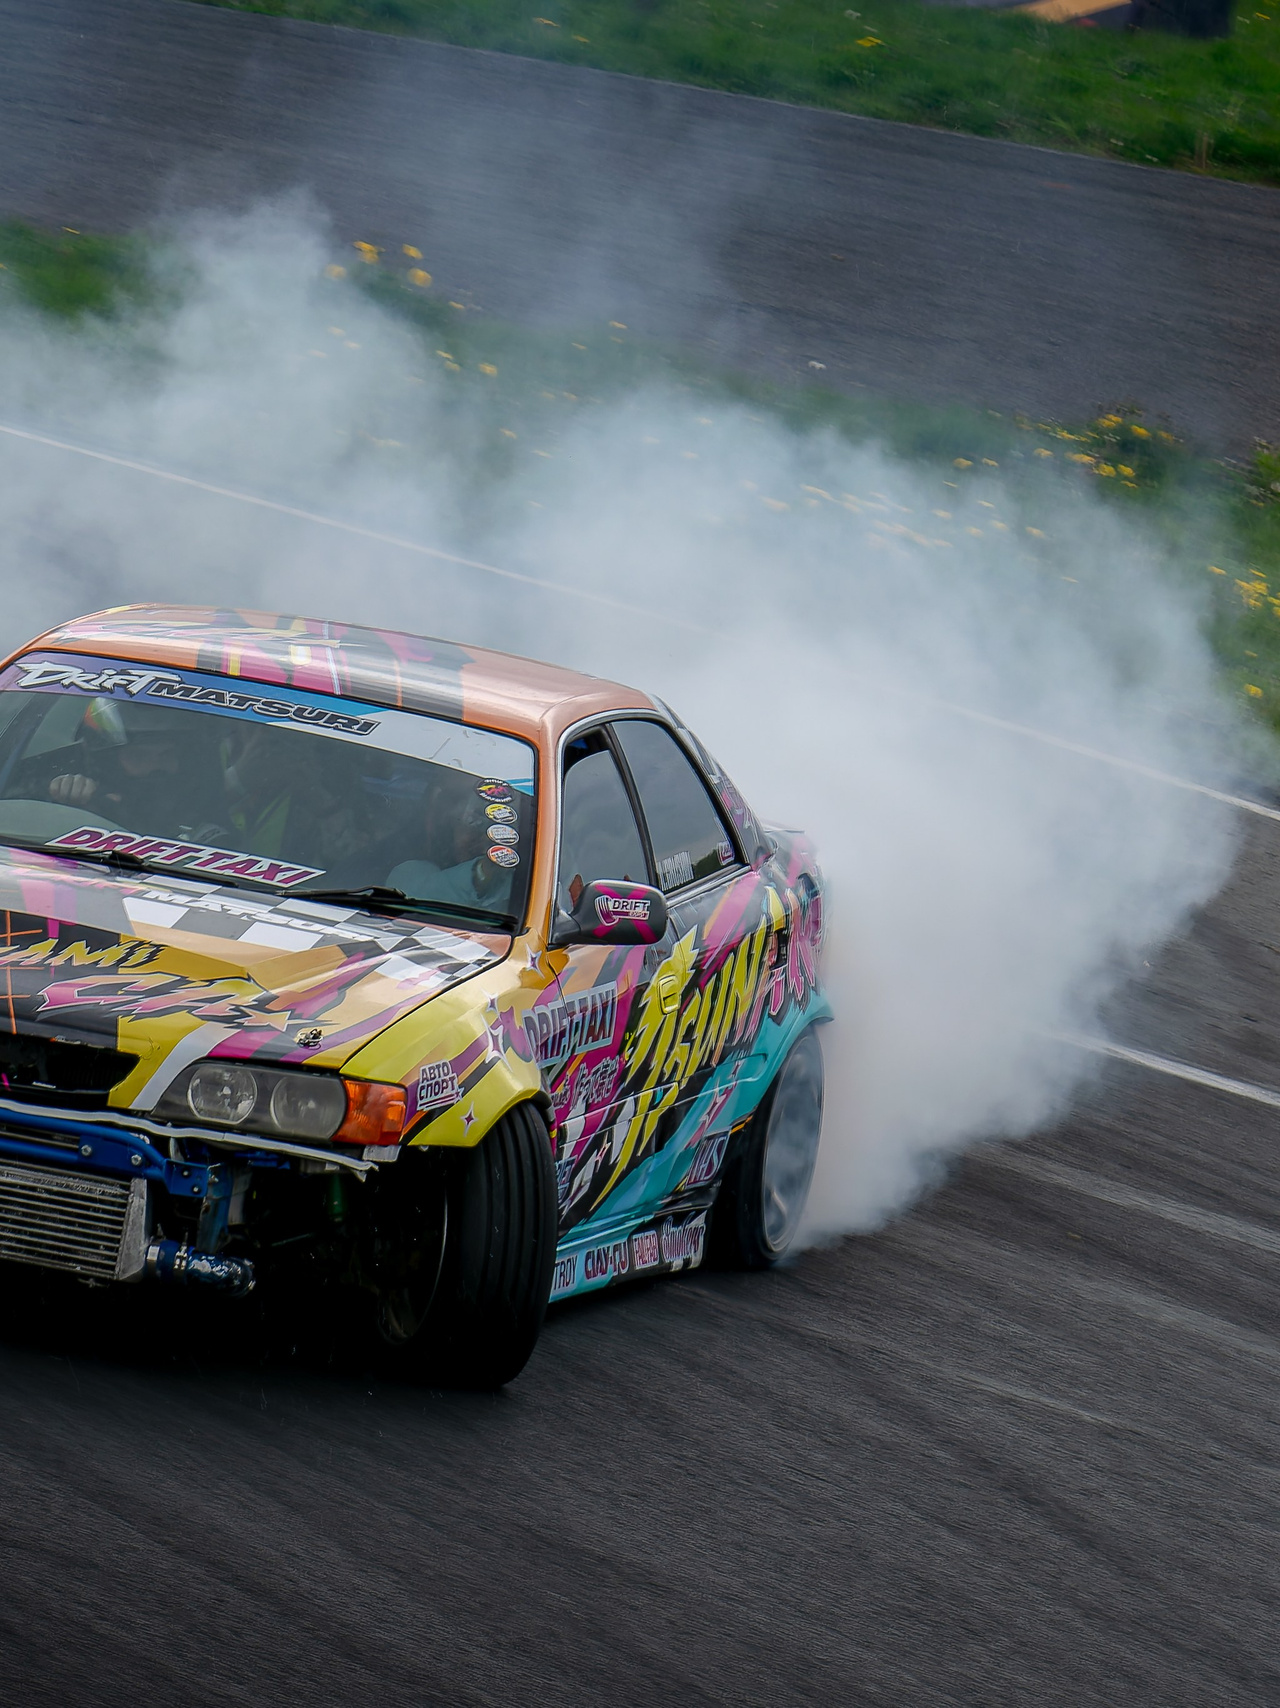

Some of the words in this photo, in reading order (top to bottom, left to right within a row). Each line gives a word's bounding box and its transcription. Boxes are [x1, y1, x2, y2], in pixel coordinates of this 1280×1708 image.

[147, 681, 381, 735] MATSURI
[52, 828, 204, 862] DRIFT
[192, 851, 320, 885] TAXI
[612, 899, 649, 911] DRIFT
[421, 1061, 451, 1084] АВТО
[419, 1075, 457, 1101] СПОРТ
